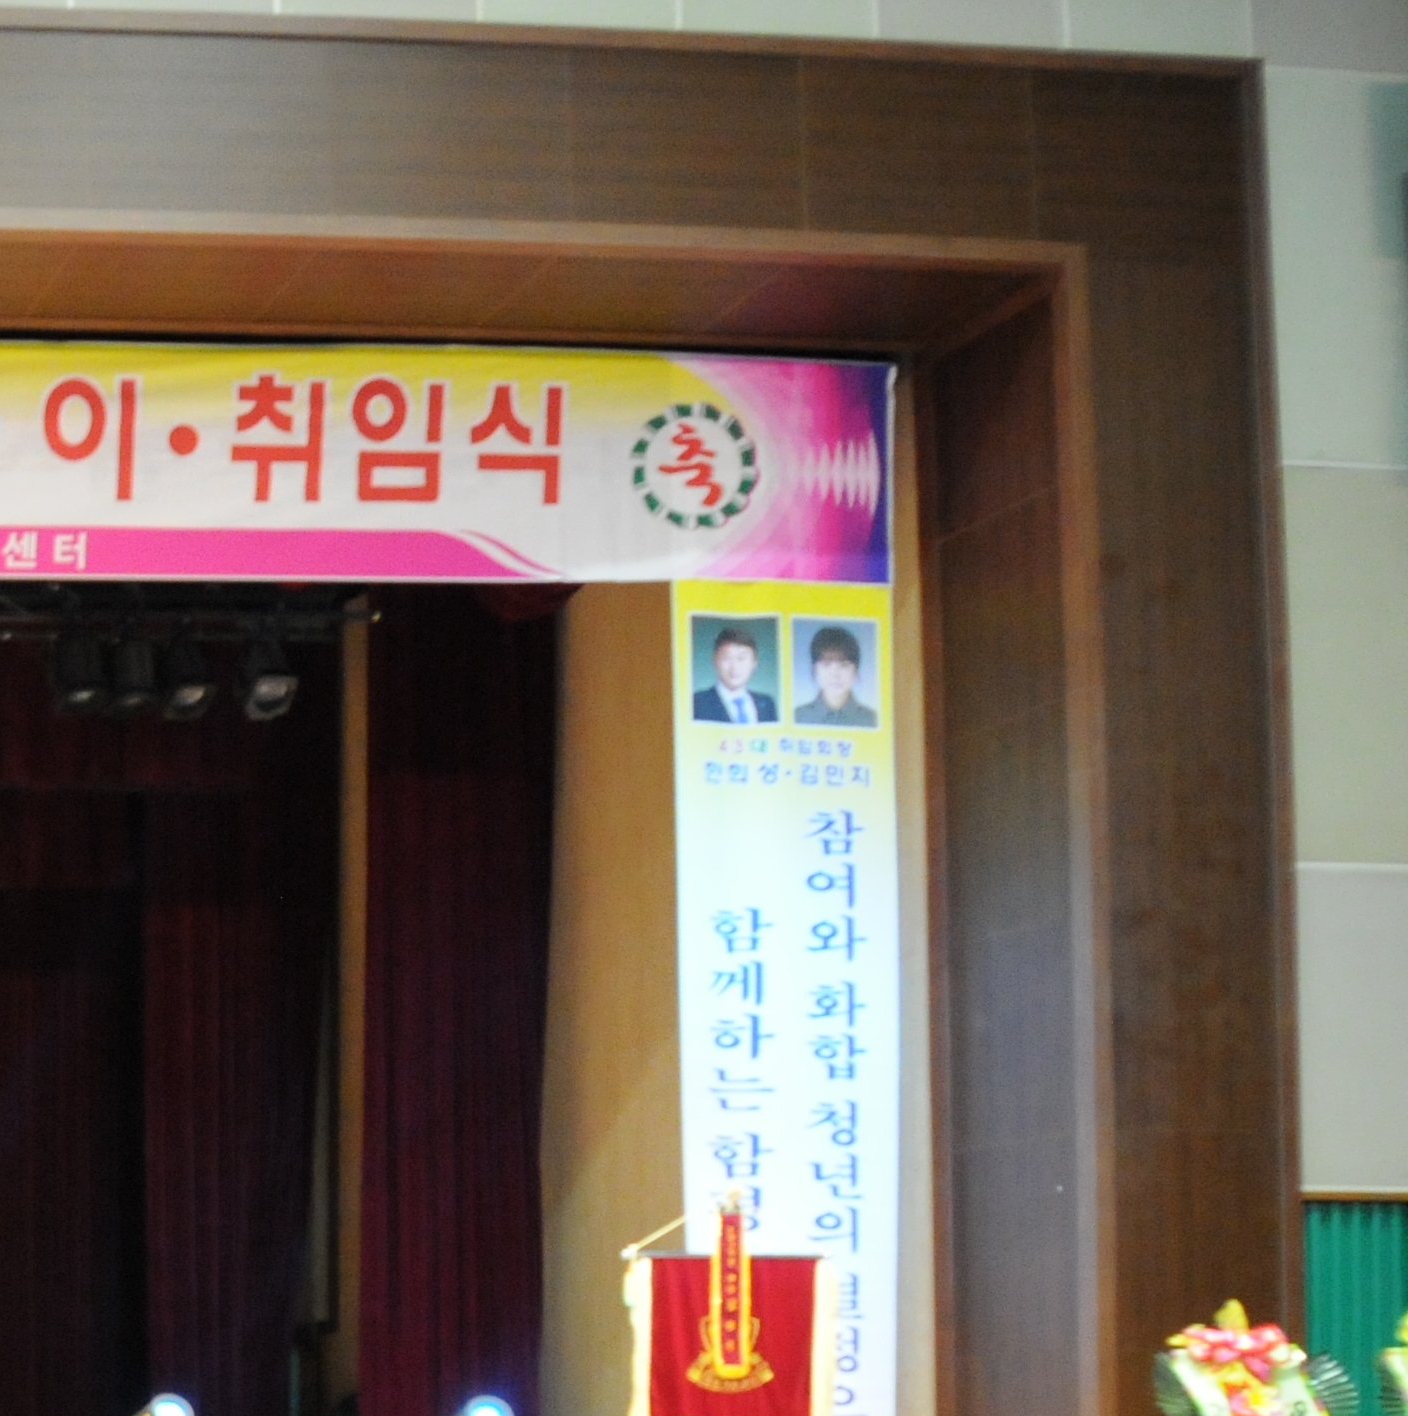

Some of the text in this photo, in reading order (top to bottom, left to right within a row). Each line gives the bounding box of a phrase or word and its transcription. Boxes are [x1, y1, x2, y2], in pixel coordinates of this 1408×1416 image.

[42, 373, 563, 504] 이·취임식
[658, 422, 724, 507] 축
[804, 809, 868, 961] 참여와
[806, 981, 868, 1081] 화합
[805, 1100, 865, 1253] 청년의
